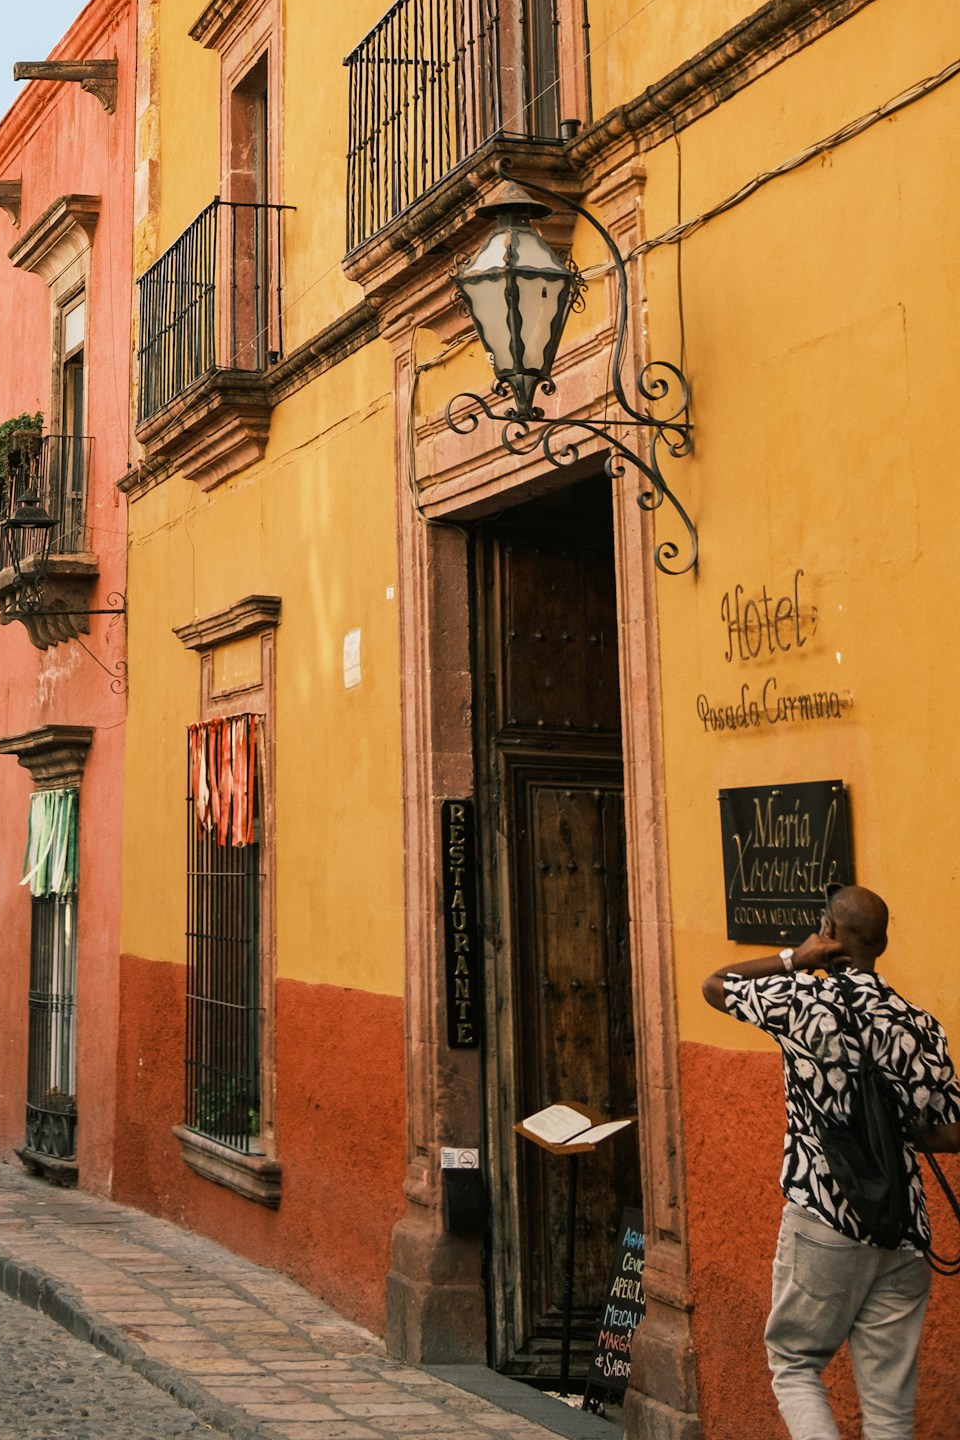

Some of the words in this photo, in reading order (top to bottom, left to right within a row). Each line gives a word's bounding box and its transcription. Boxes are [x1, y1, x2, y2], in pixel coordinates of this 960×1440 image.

[721, 568, 807, 662] Hotel
[697, 683, 760, 732] Posada
[763, 677, 841, 724] Carmina
[753, 796, 811, 848] María
[449, 803, 473, 1044] RESTAURANTE
[734, 906, 767, 925] COCINA
